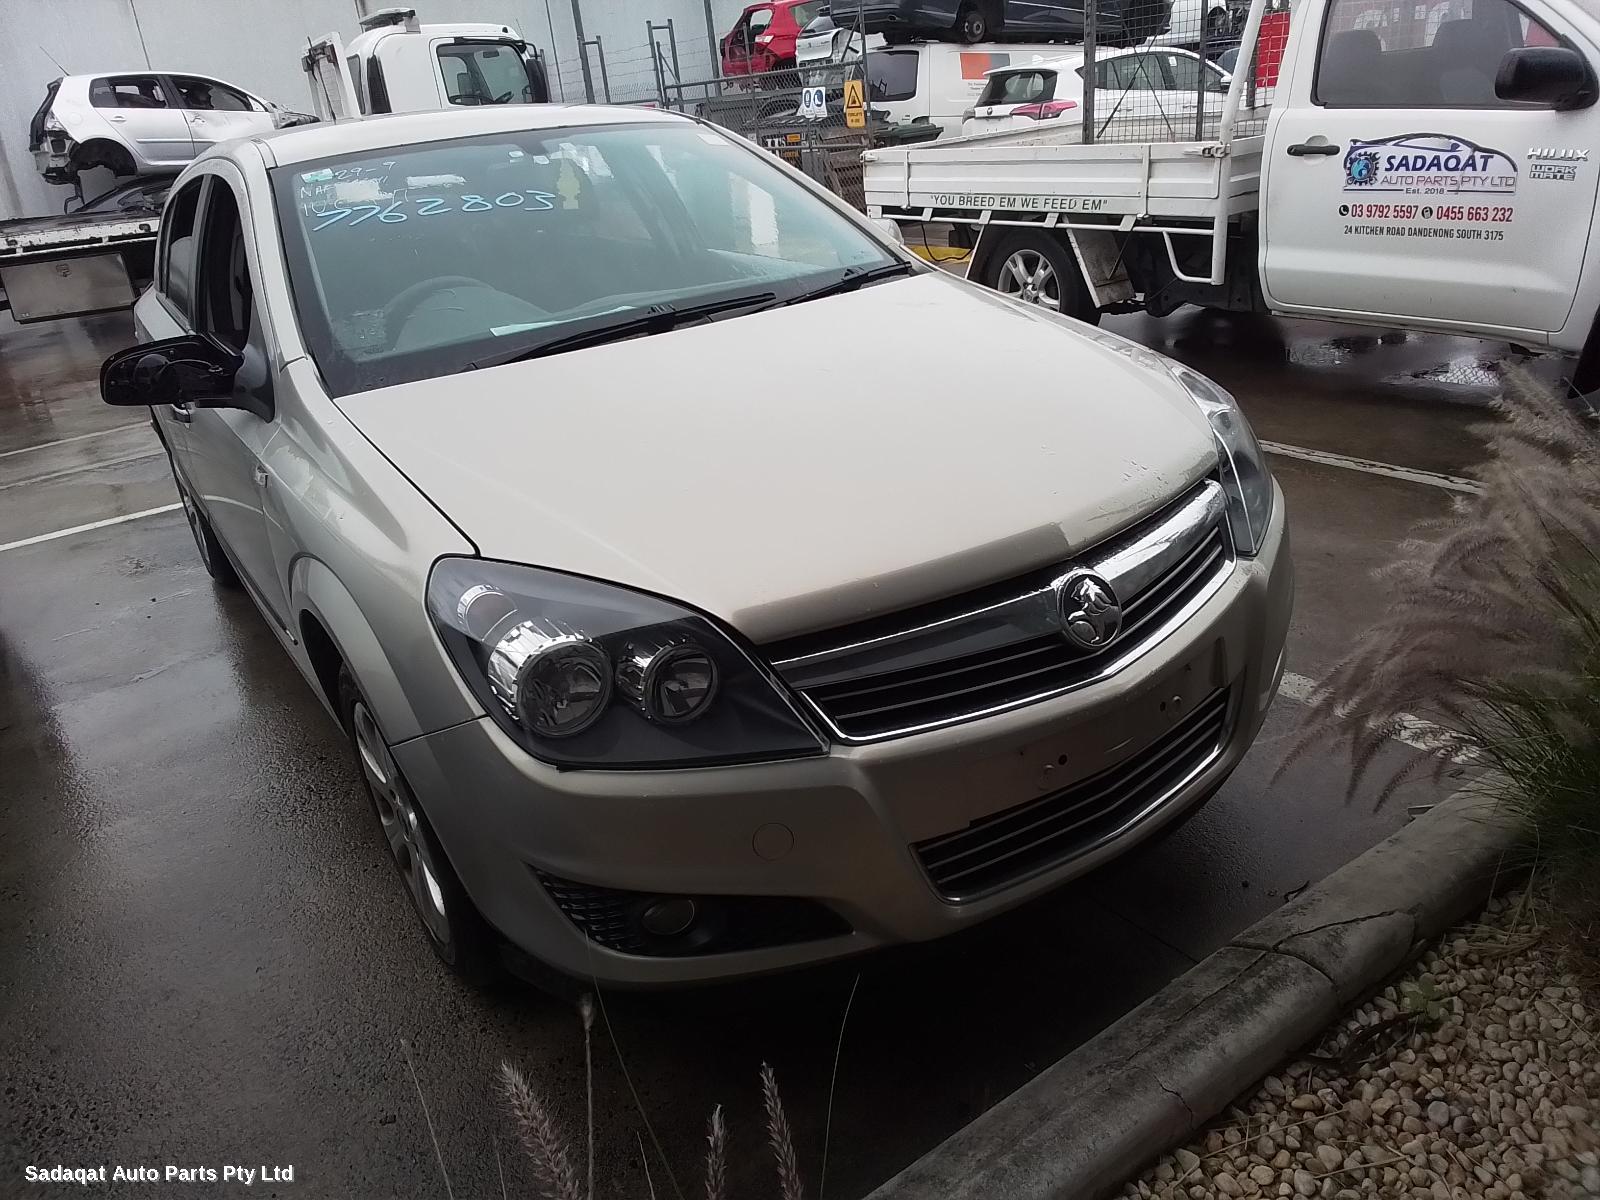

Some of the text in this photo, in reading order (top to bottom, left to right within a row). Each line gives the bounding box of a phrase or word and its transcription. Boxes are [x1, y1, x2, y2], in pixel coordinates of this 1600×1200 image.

[1385, 154, 1494, 172] SADAQAT
[1531, 164, 1577, 173] WORK
[1381, 175, 1516, 187] AUTO PARTS PTY LTD
[1529, 171, 1575, 181] MATE
[1405, 187, 1445, 195] Est. 2018
[312, 190, 556, 231] 7762803
[958, 195, 996, 207] BREED
[999, 196, 1017, 208] EM
[1020, 197, 1039, 209] WE
[1043, 198, 1077, 210] FEED
[1081, 199, 1108, 211] EM"
[1351, 204, 1514, 223] 03 9792 5597 0455 663 232
[1344, 225, 1505, 241] 24 KITCHEN ROAD DANDENONG SOUTH 3175
